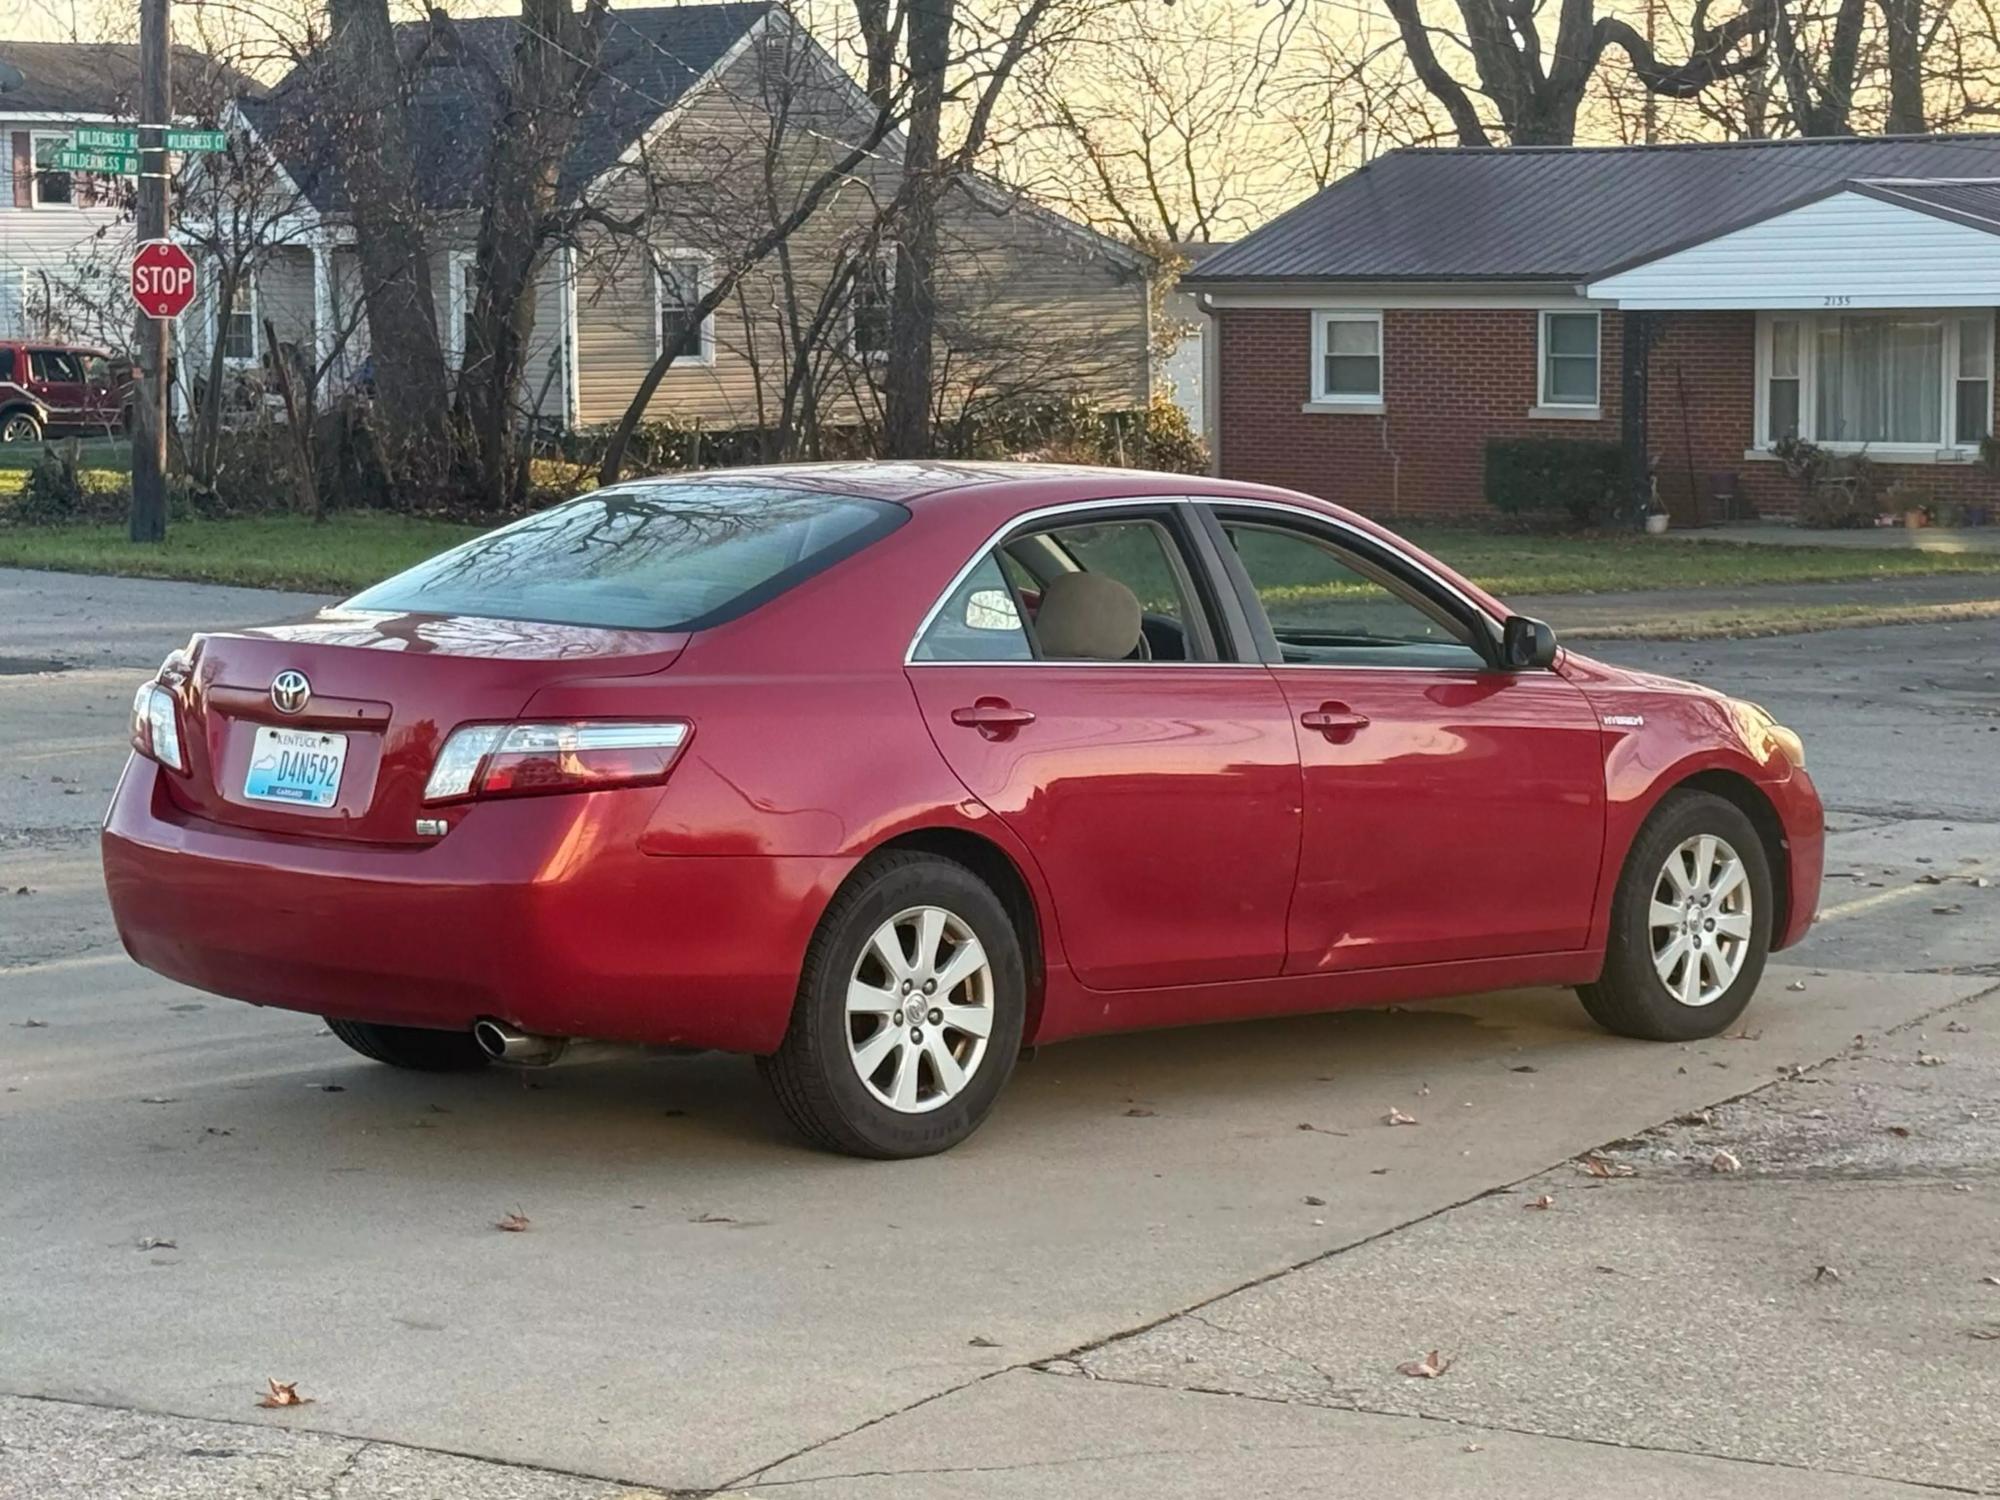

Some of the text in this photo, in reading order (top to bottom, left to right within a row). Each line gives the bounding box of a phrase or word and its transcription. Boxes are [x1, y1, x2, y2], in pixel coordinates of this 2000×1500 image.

[78, 130, 126, 148] WILDERNESS
[167, 133, 225, 149] WILDERNESS CT
[62, 151, 138, 173] WILDERNESS RD
[135, 265, 192, 296] STOP
[277, 750, 339, 788] D4N592
